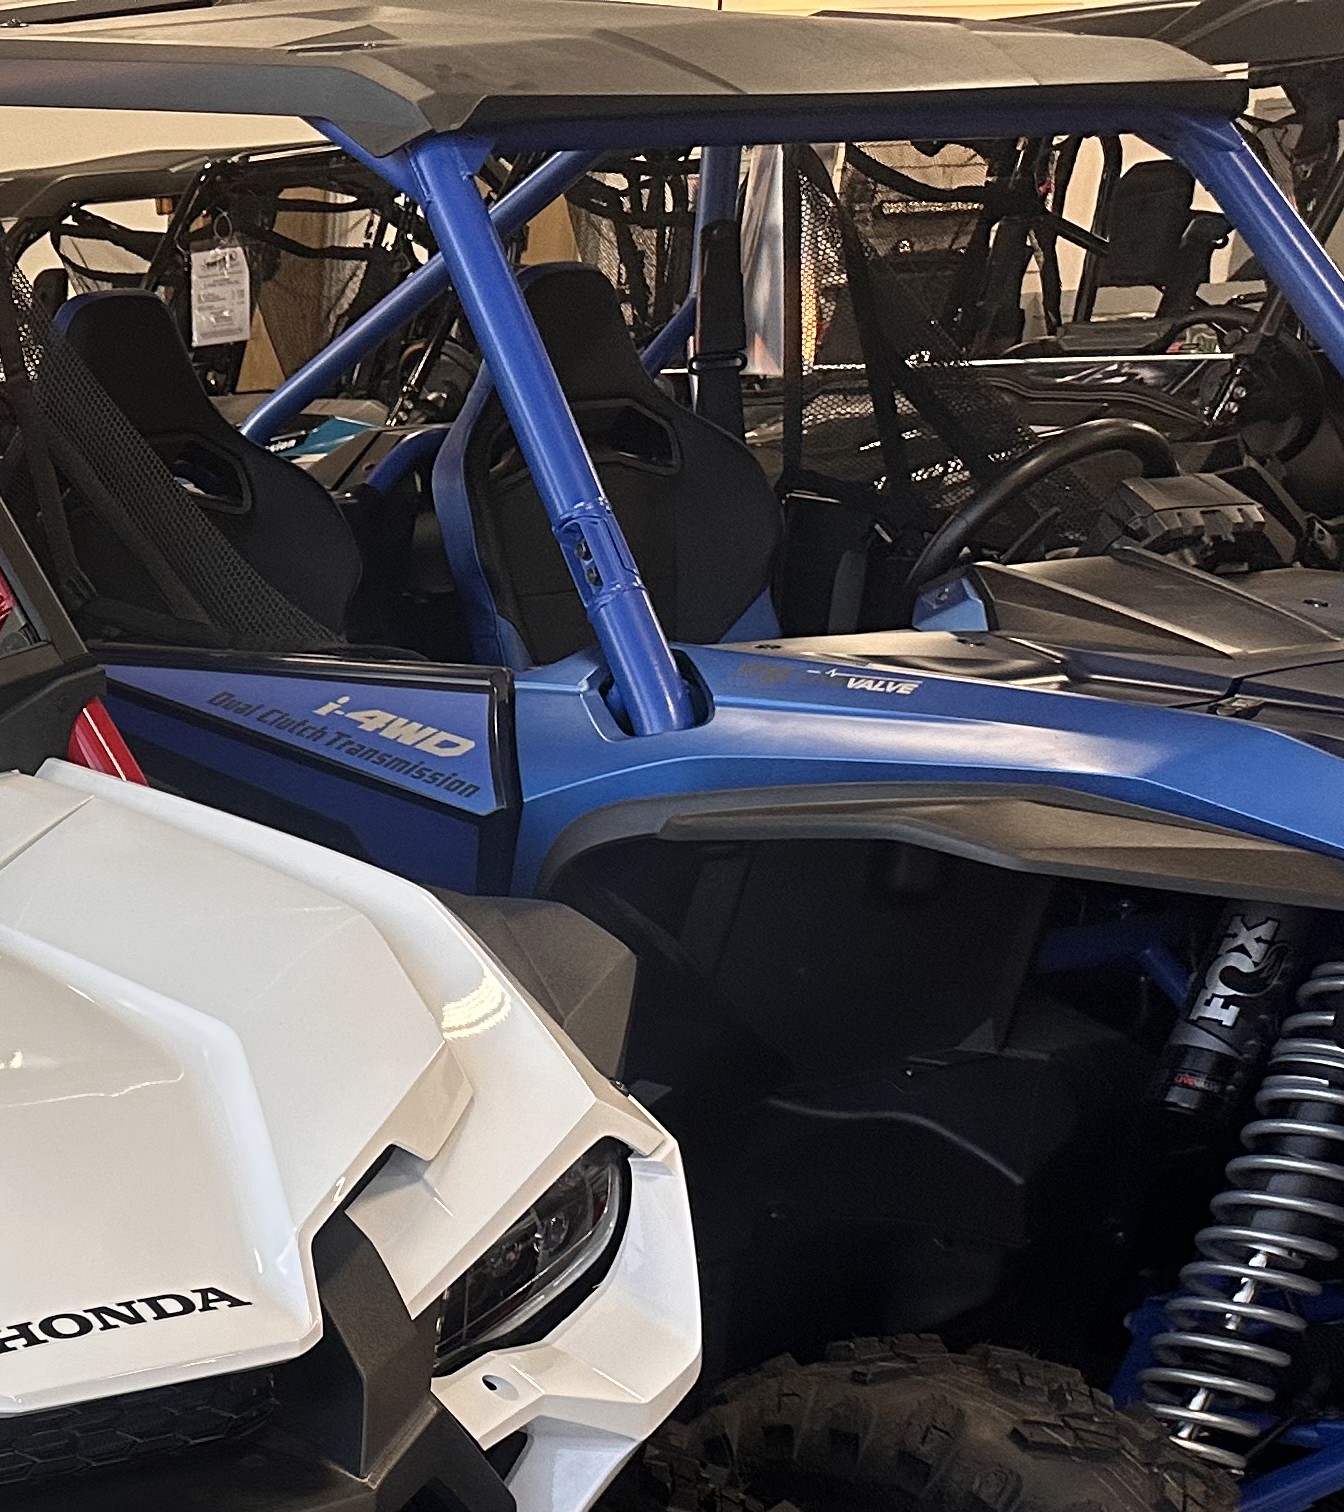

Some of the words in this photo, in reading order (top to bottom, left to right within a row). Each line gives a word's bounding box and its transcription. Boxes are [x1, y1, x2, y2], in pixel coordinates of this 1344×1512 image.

[208, 691, 259, 717] Dual
[256, 708, 328, 742] Clutch
[324, 732, 481, 798] Transmission
[312, 696, 475, 757] i-4WD
[1189, 915, 1282, 1027] FOX
